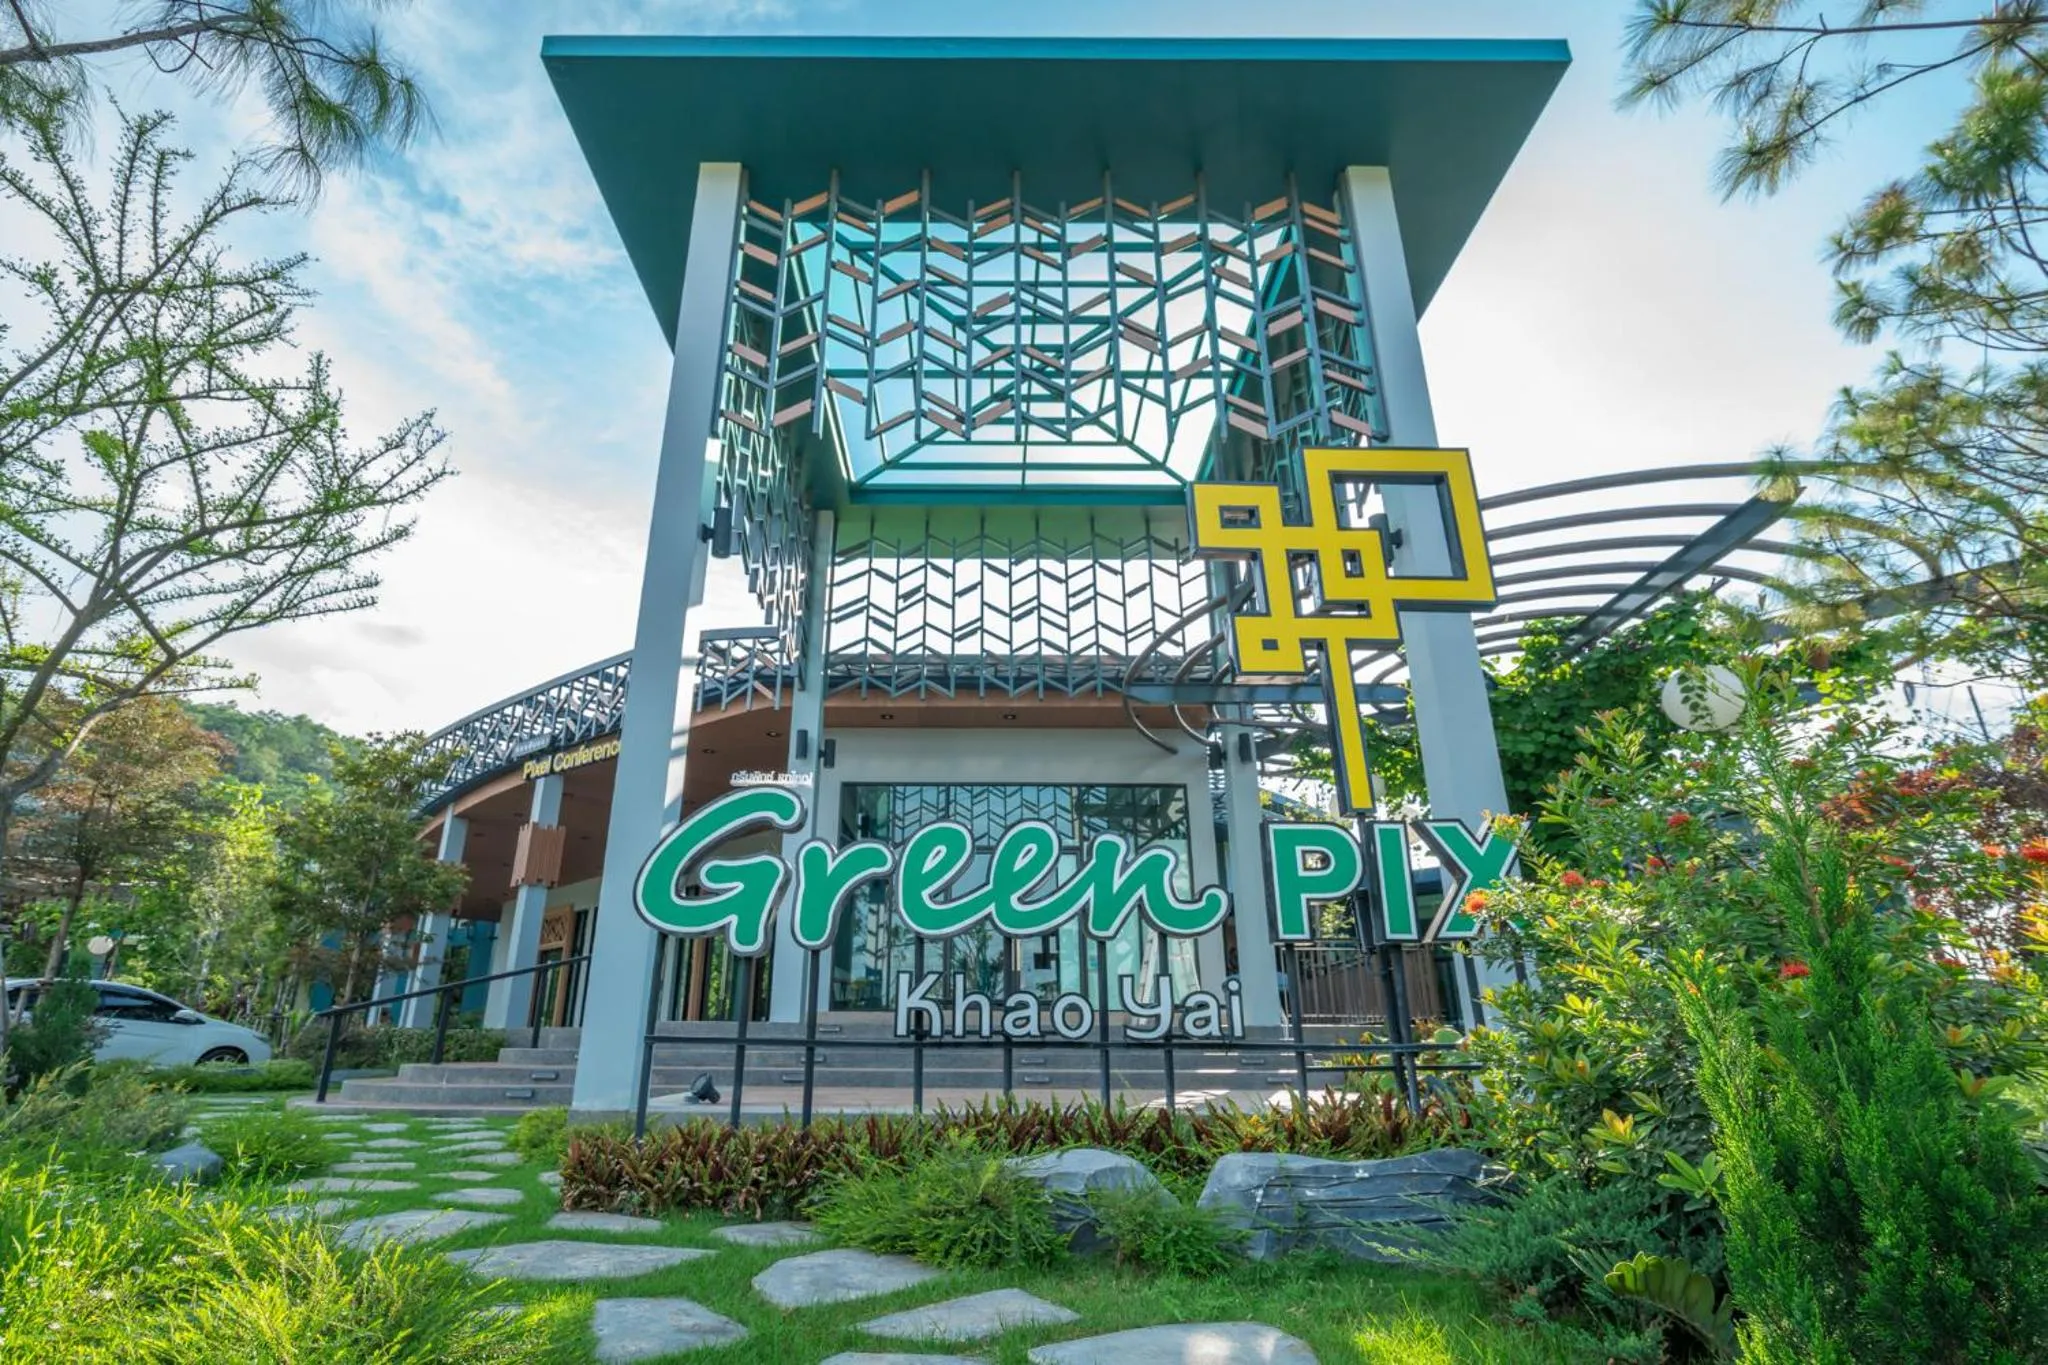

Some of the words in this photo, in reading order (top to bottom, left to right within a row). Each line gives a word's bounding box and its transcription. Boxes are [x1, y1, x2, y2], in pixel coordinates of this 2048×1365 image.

[523, 755, 552, 779] Pixel
[635, 788, 1229, 956] Green
[1264, 819, 1532, 942] PIX
[895, 970, 1094, 1039] Khao
[1118, 974, 1245, 1040] Yai
